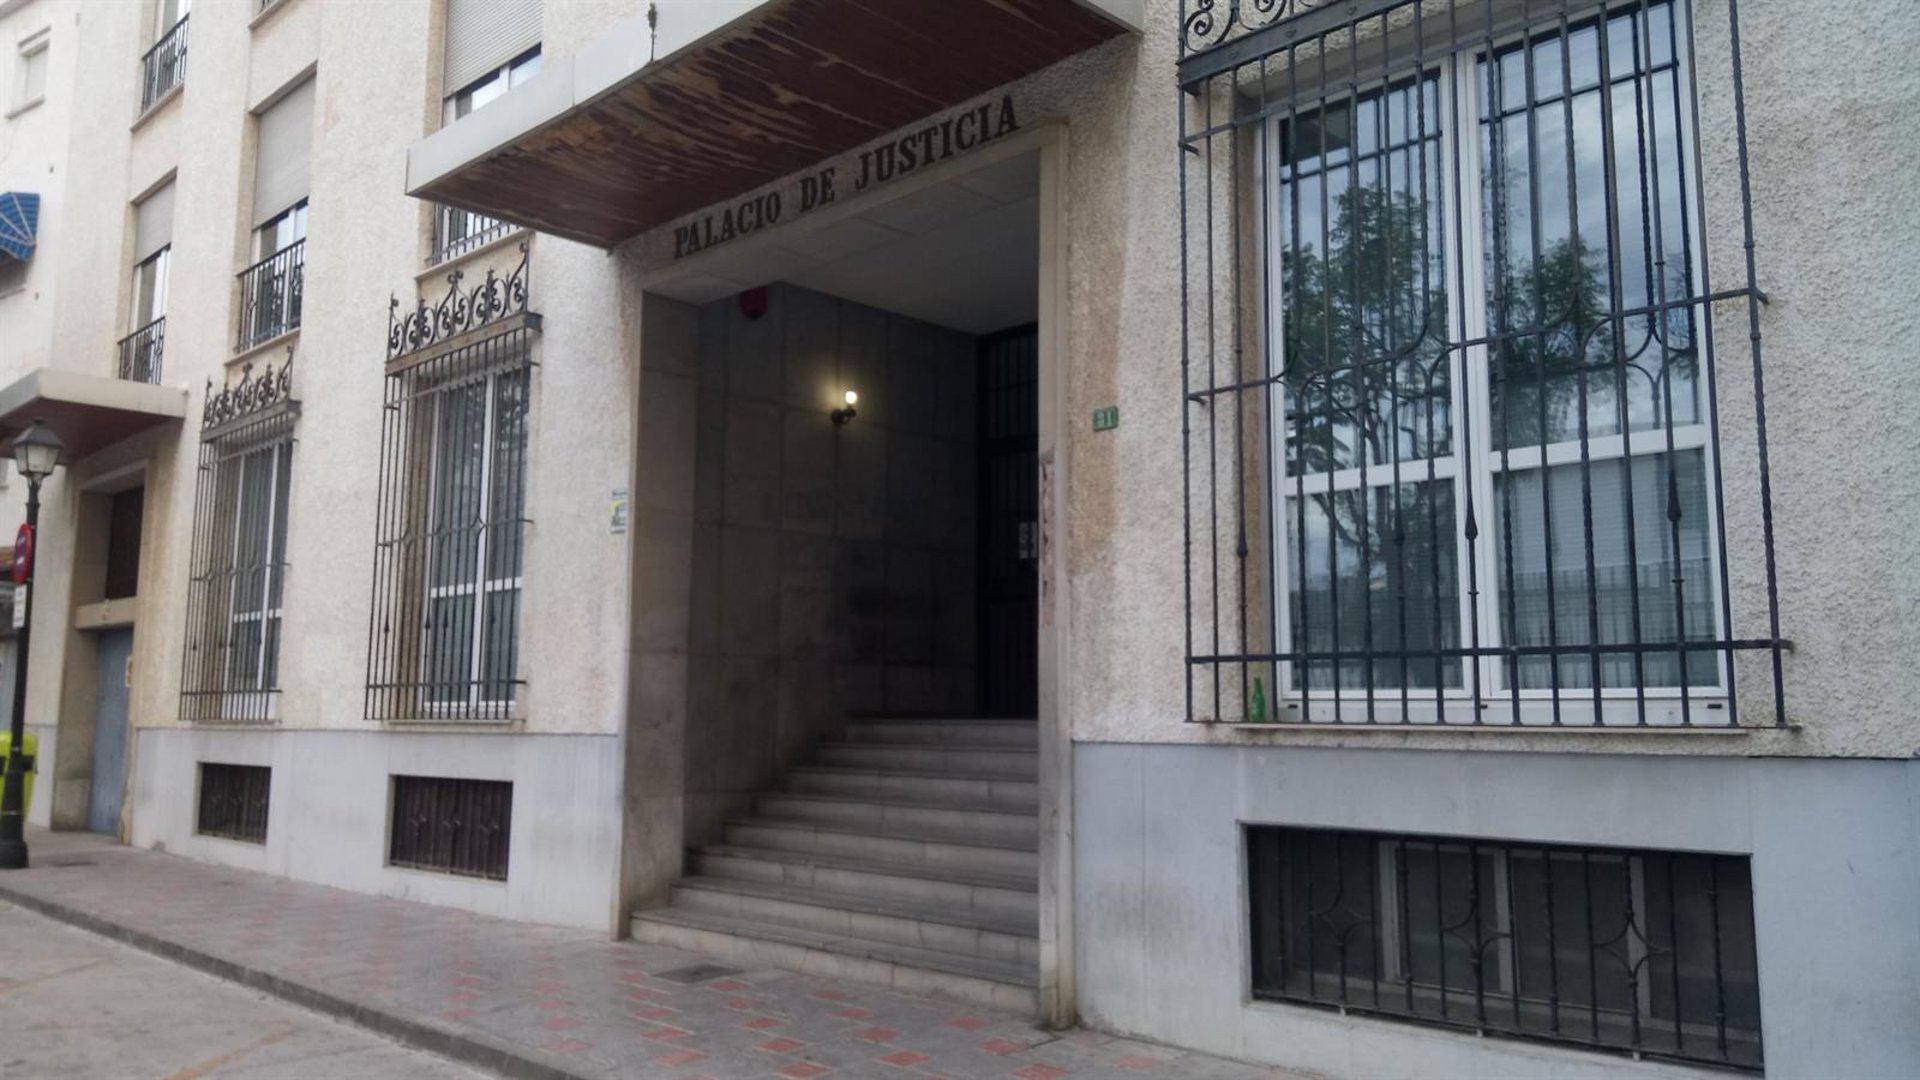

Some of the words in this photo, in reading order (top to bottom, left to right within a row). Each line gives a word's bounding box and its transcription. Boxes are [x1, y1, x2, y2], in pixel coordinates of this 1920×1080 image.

[674, 190, 781, 260] PALACIO
[800, 167, 836, 213] DE
[855, 94, 1021, 191] JUSTICIA
